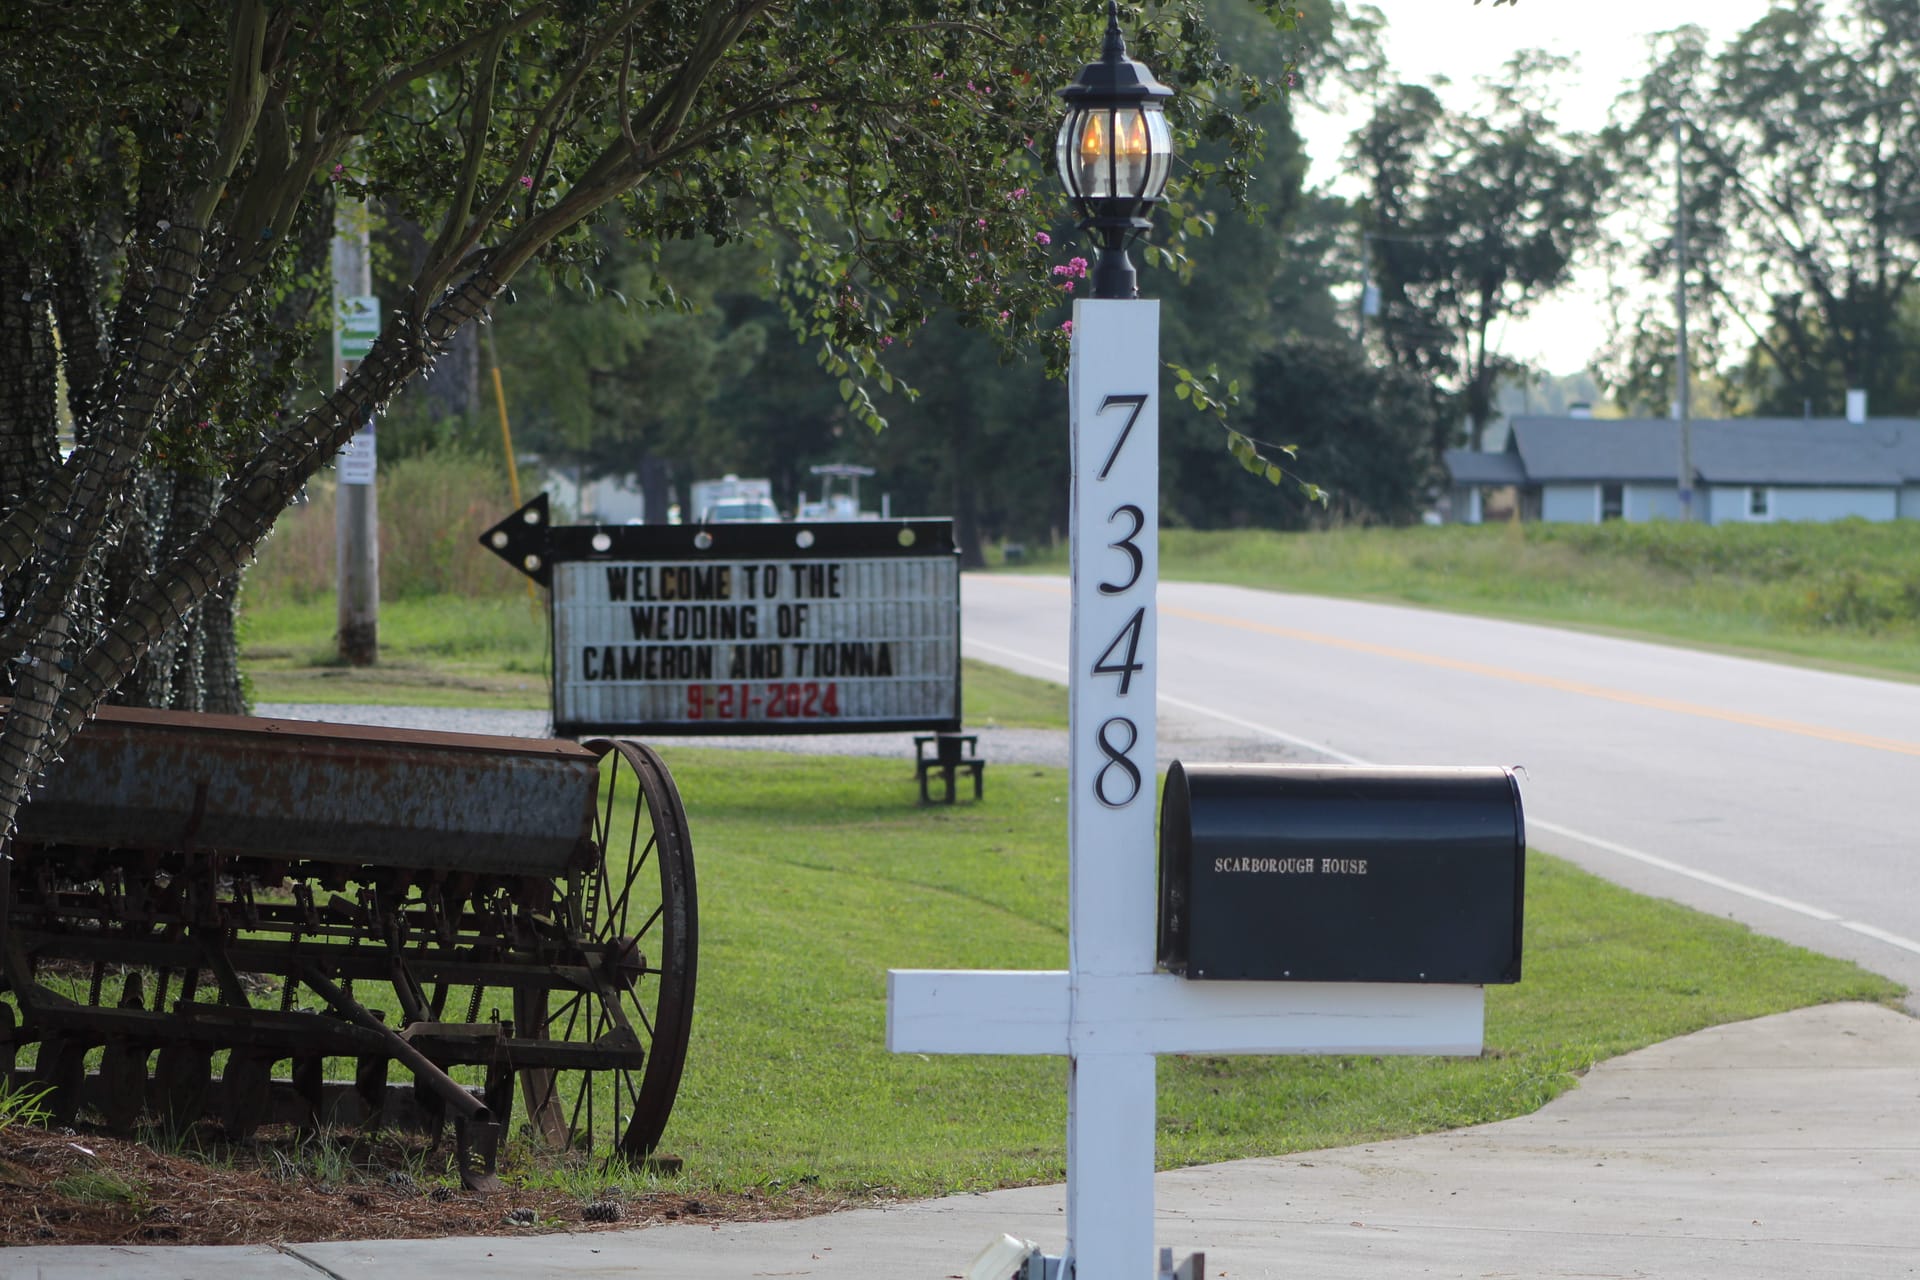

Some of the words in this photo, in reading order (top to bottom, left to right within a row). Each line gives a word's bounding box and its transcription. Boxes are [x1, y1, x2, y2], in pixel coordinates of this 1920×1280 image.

[606, 565, 731, 602] WELCOME
[743, 564, 779, 600] TO
[790, 563, 841, 599] THE
[1091, 394, 1149, 809] 7348
[631, 604, 757, 640] WEDDING
[777, 604, 809, 638] OF
[583, 645, 712, 681] CAMERON
[730, 643, 783, 679] AND
[793, 641, 893, 677] TIONNA
[687, 681, 839, 720] 9-21-2024
[1214, 857, 1314, 874] SCARBOROUGH
[1321, 858, 1368, 875] HOUSE
